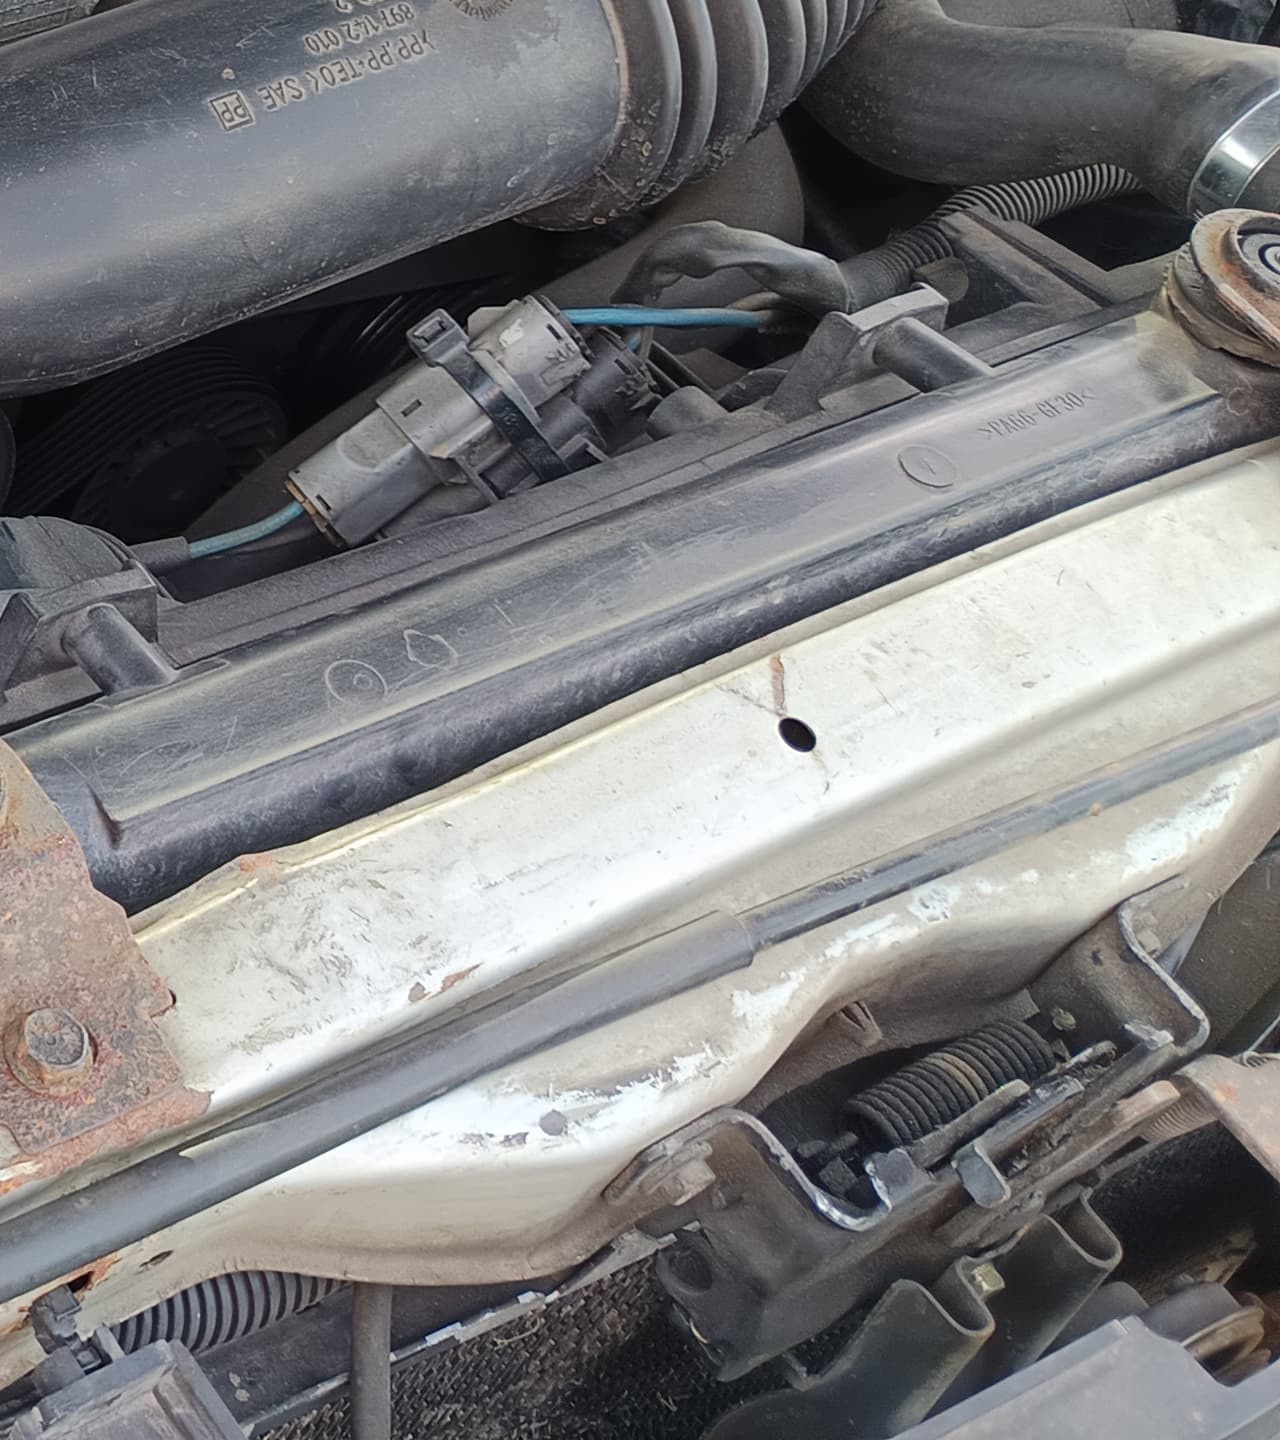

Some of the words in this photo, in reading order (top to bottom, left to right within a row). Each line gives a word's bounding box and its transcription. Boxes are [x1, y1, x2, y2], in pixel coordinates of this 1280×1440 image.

[380, 2, 416, 27] 897
[304, 29, 341, 54] 010
[344, 15, 381, 42] 142
[257, 76, 304, 111] SAE
[220, 94, 249, 123] PP
